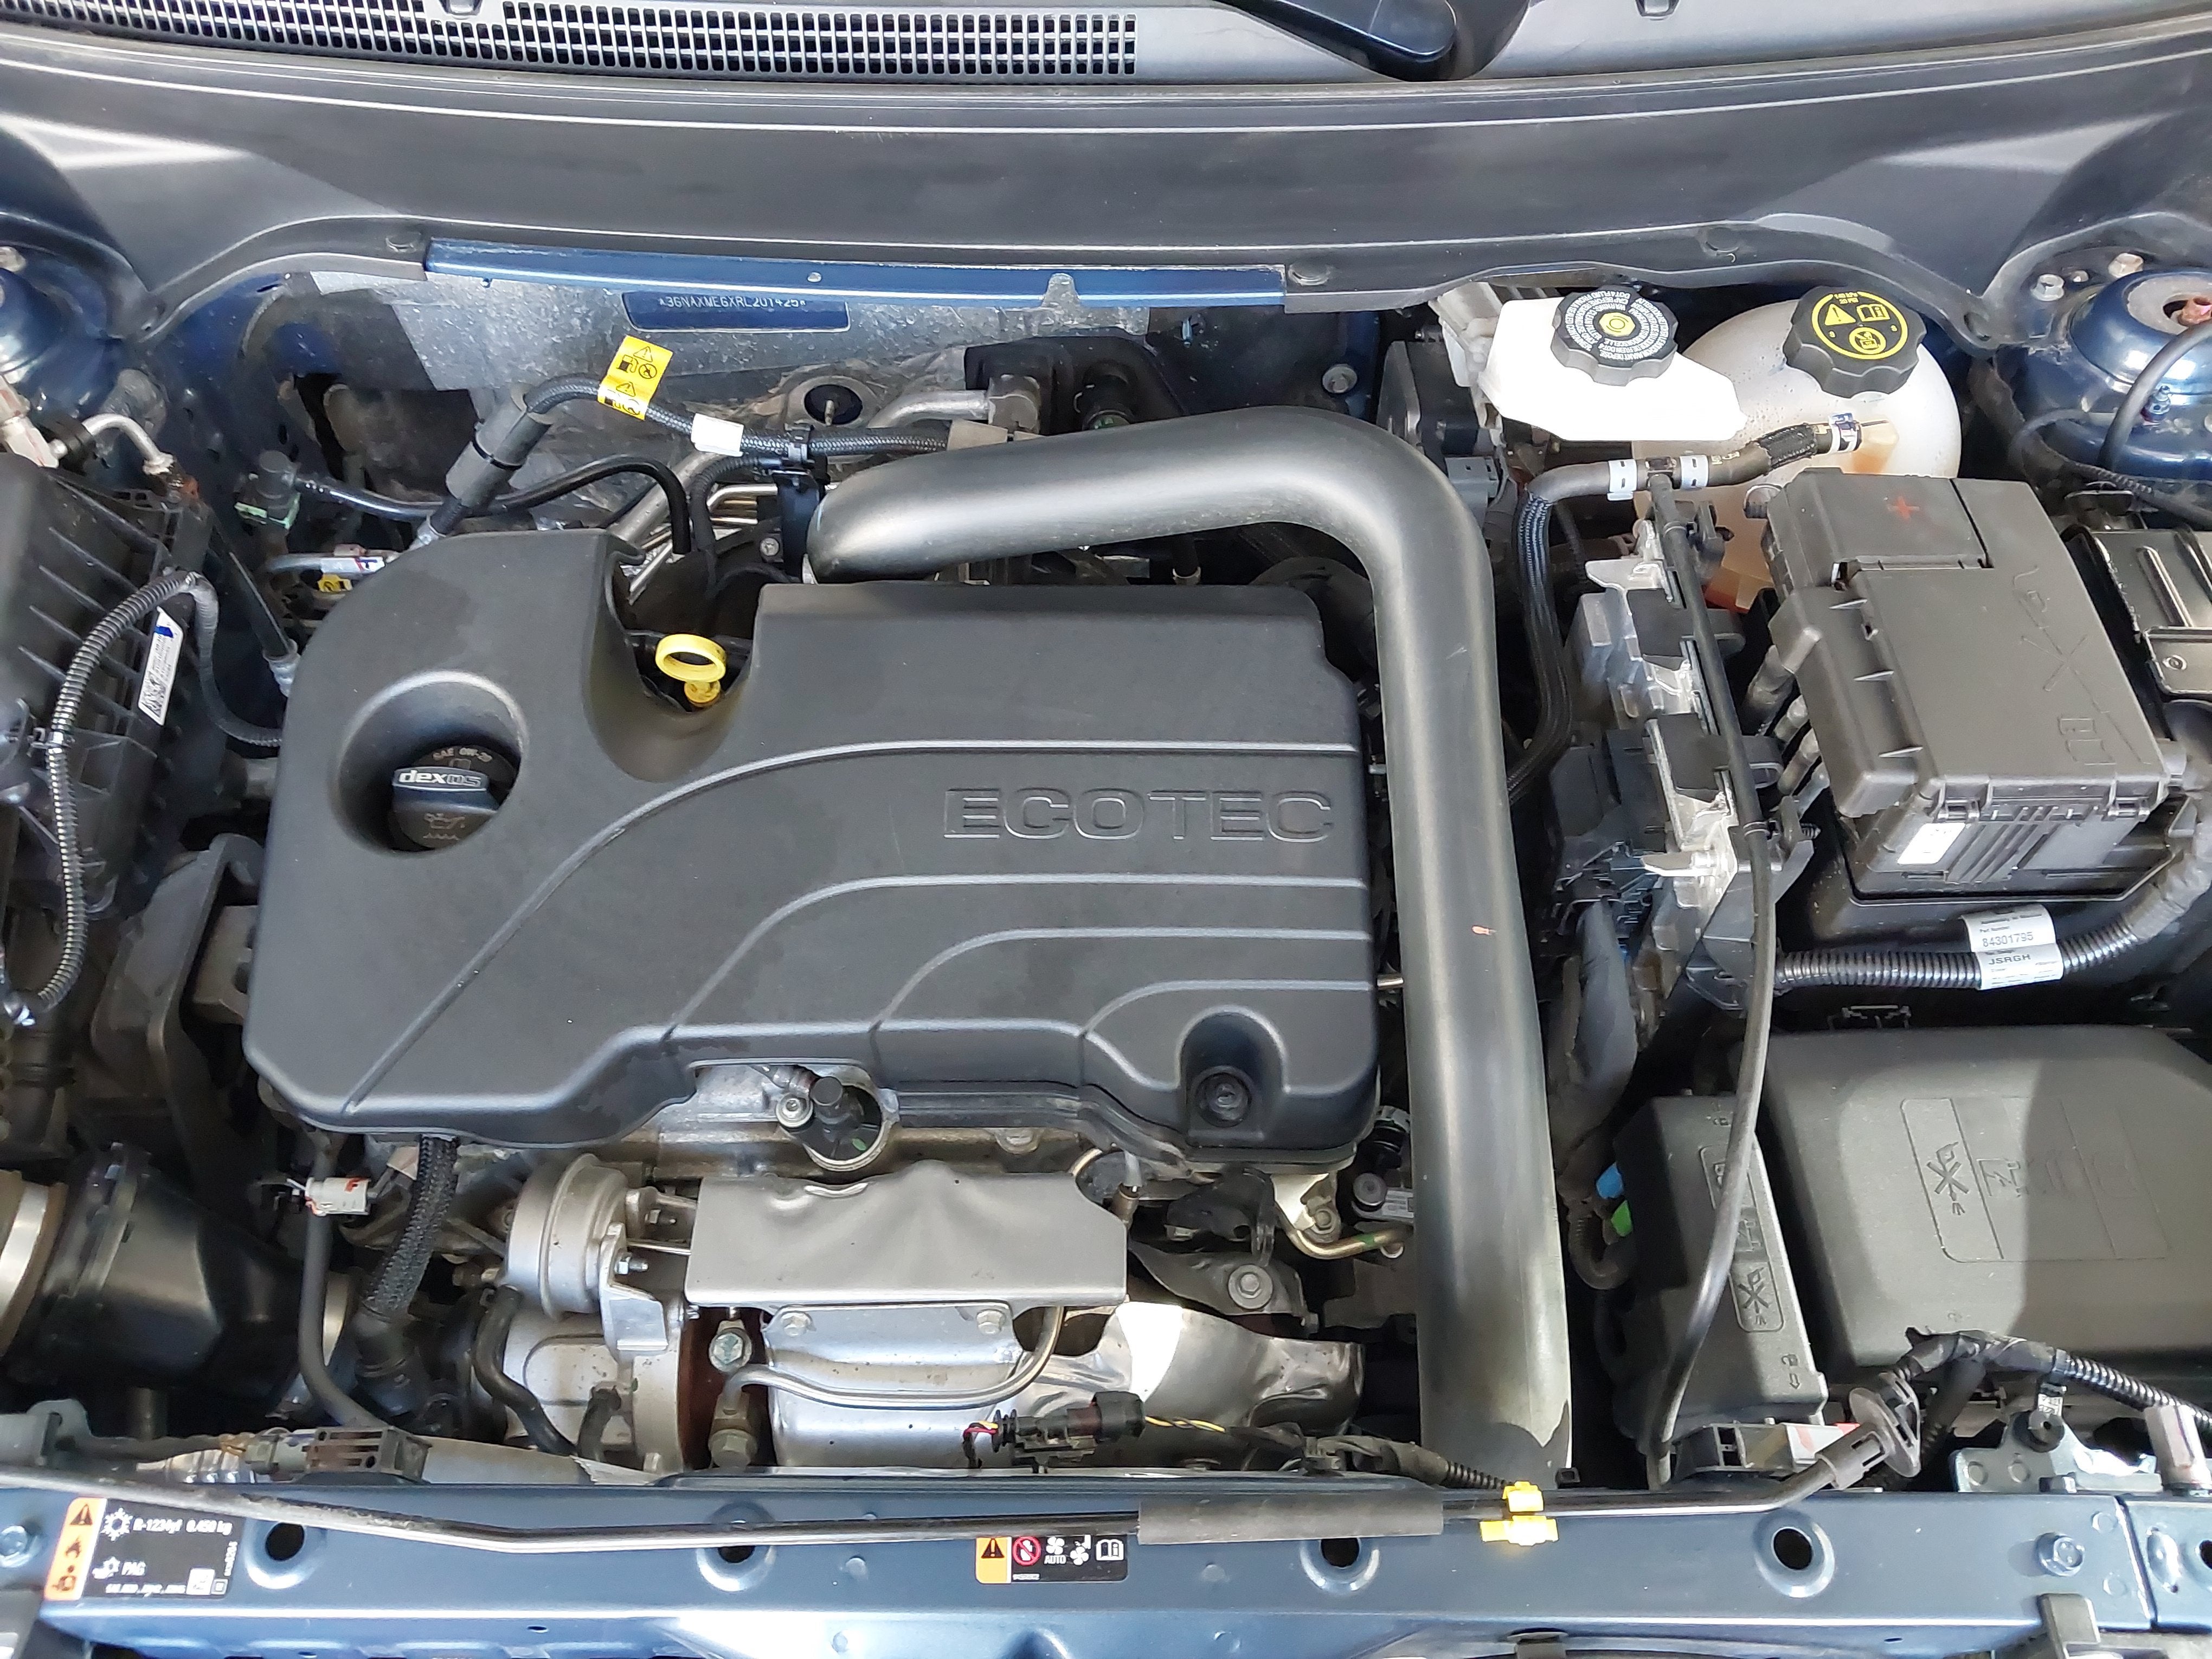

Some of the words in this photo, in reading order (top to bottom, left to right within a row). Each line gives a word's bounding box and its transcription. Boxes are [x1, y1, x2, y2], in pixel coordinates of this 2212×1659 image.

[1613, 297, 1629, 306] CAP
[1615, 291, 1631, 301] DOT
[399, 770, 481, 787] dexos
[944, 788, 1334, 842] ECOTEC
[1982, 931, 2034, 947] 84301795
[1989, 954, 2031, 965] JSRGH
[1044, 1555, 1066, 1564] AUTO
[121, 1561, 146, 1576] PAG
